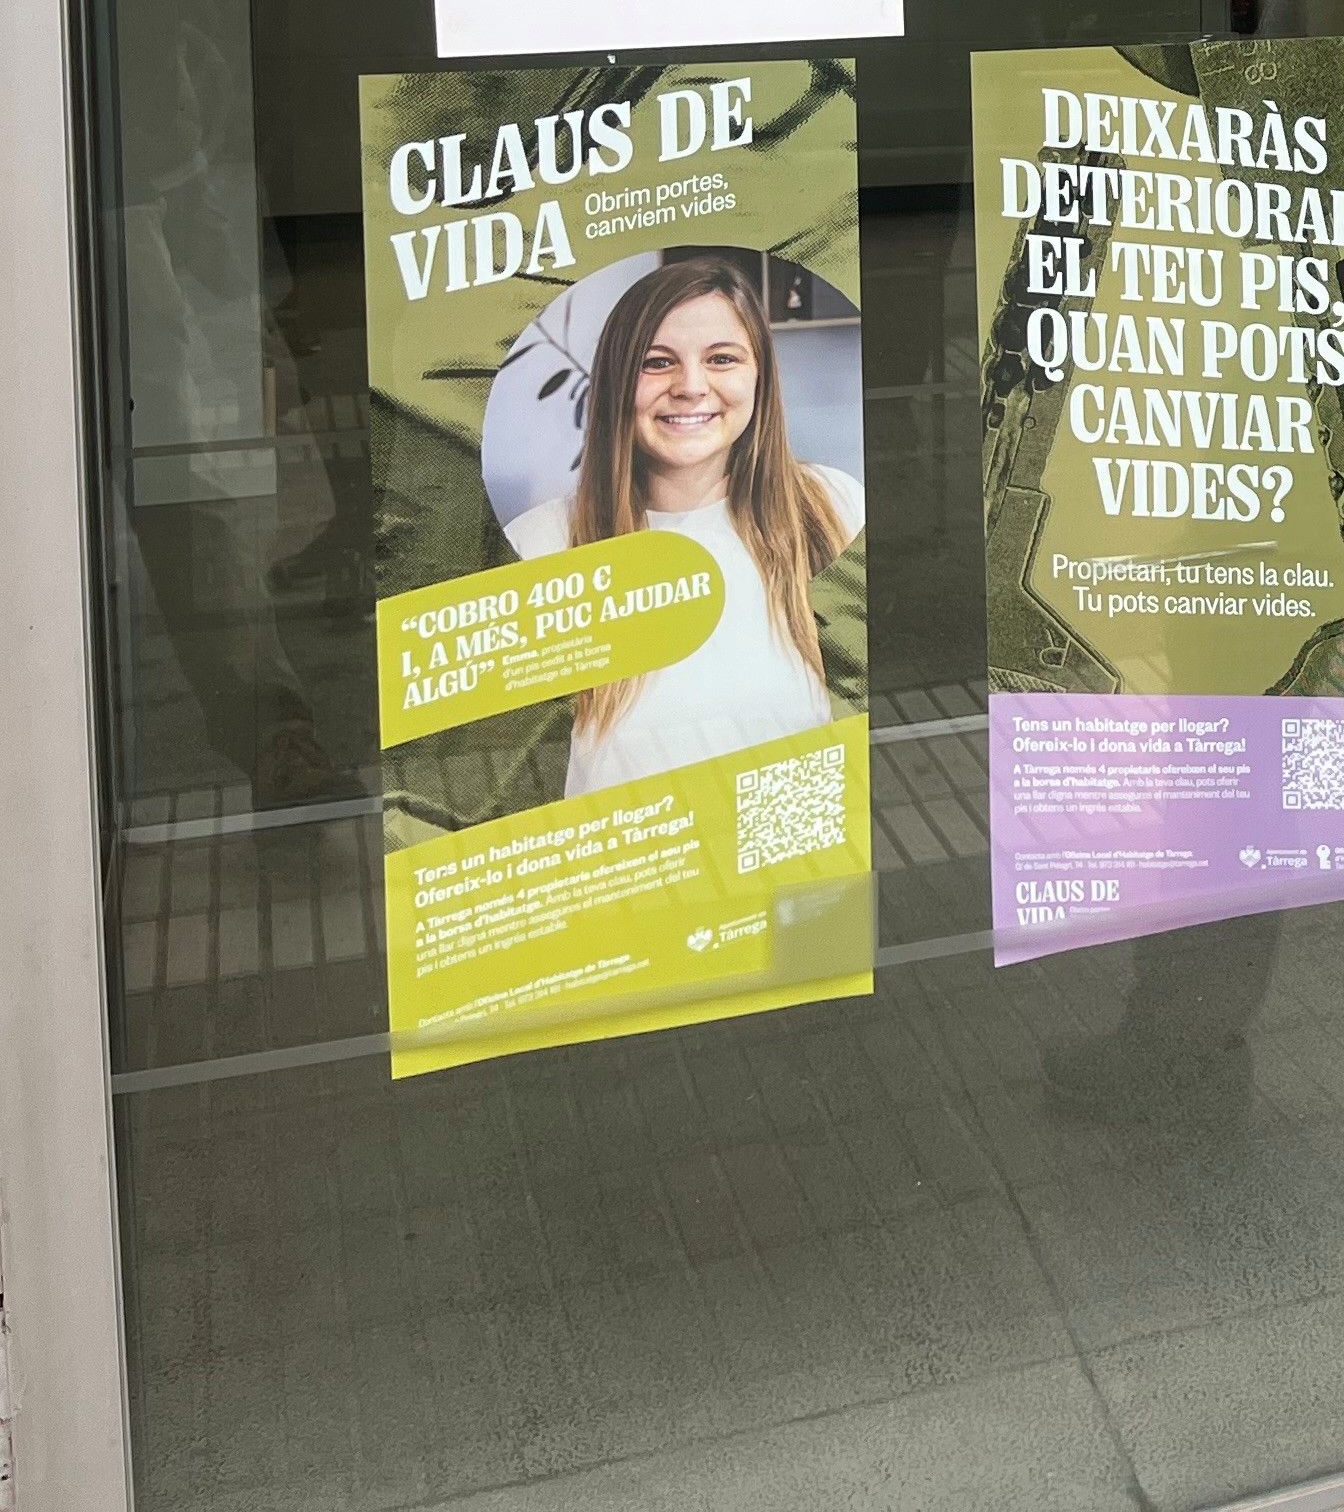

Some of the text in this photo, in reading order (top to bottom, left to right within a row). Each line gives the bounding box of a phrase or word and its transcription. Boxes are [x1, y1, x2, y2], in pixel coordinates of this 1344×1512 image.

[390, 77, 753, 215] CLAUS DE
[1042, 88, 1327, 175] DEIXARÀS
[584, 173, 729, 216] Obrim portes,
[585, 191, 737, 240] canviem vides
[390, 200, 576, 302] VIDA
[1025, 233, 1096, 298] EL
[1112, 241, 1223, 307] TEU
[1026, 307, 1186, 382] QUAN
[1069, 383, 1315, 454] CANVIAR
[1093, 457, 1293, 523] VIDES?
[527, 572, 584, 609] 400
[593, 565, 612, 591] €
[1052, 554, 1334, 588] Propietari, tu tens la clau.
[429, 642, 448, 669] A
[456, 621, 528, 661] MÉS,
[535, 602, 592, 639] PUC
[599, 571, 711, 623] AJUDAR
[1072, 586, 1315, 617] Tu pots canviar vides.
[1012, 717, 1229, 736] Tens un habitatge per llogar?
[1013, 737, 1246, 755] Ofereix-lo i dona vida a Tàrrega!
[414, 794, 674, 885] Tens un habitatge per llogar?
[1267, 856, 1307, 868] Tàrrega
[1016, 880, 1119, 904] CLAUS DE
